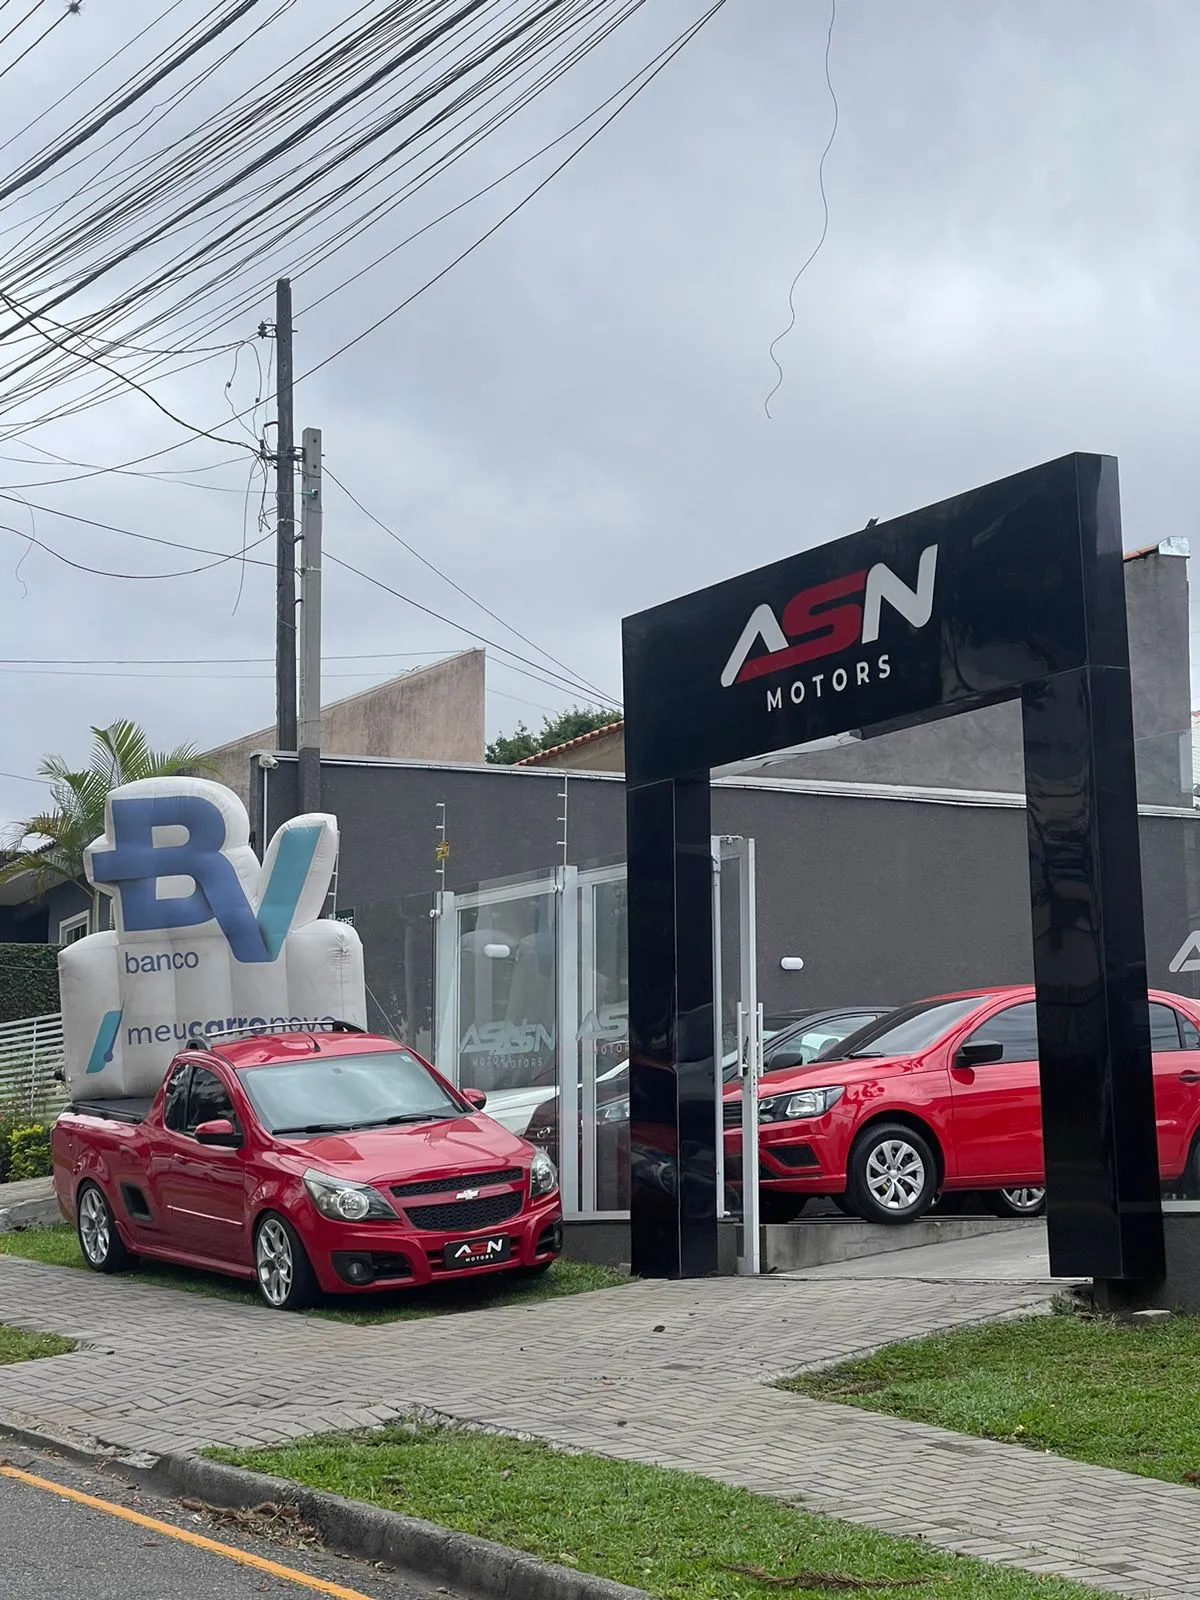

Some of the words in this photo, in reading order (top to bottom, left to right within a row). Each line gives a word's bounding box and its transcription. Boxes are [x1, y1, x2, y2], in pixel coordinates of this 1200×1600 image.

[720, 543, 938, 687] ASN
[766, 654, 892, 712] MOTORS
[92, 796, 322, 962] BV
[125, 950, 199, 974] banco
[454, 1239, 503, 1258] ASN
[465, 1254, 494, 1262] MOTORS
